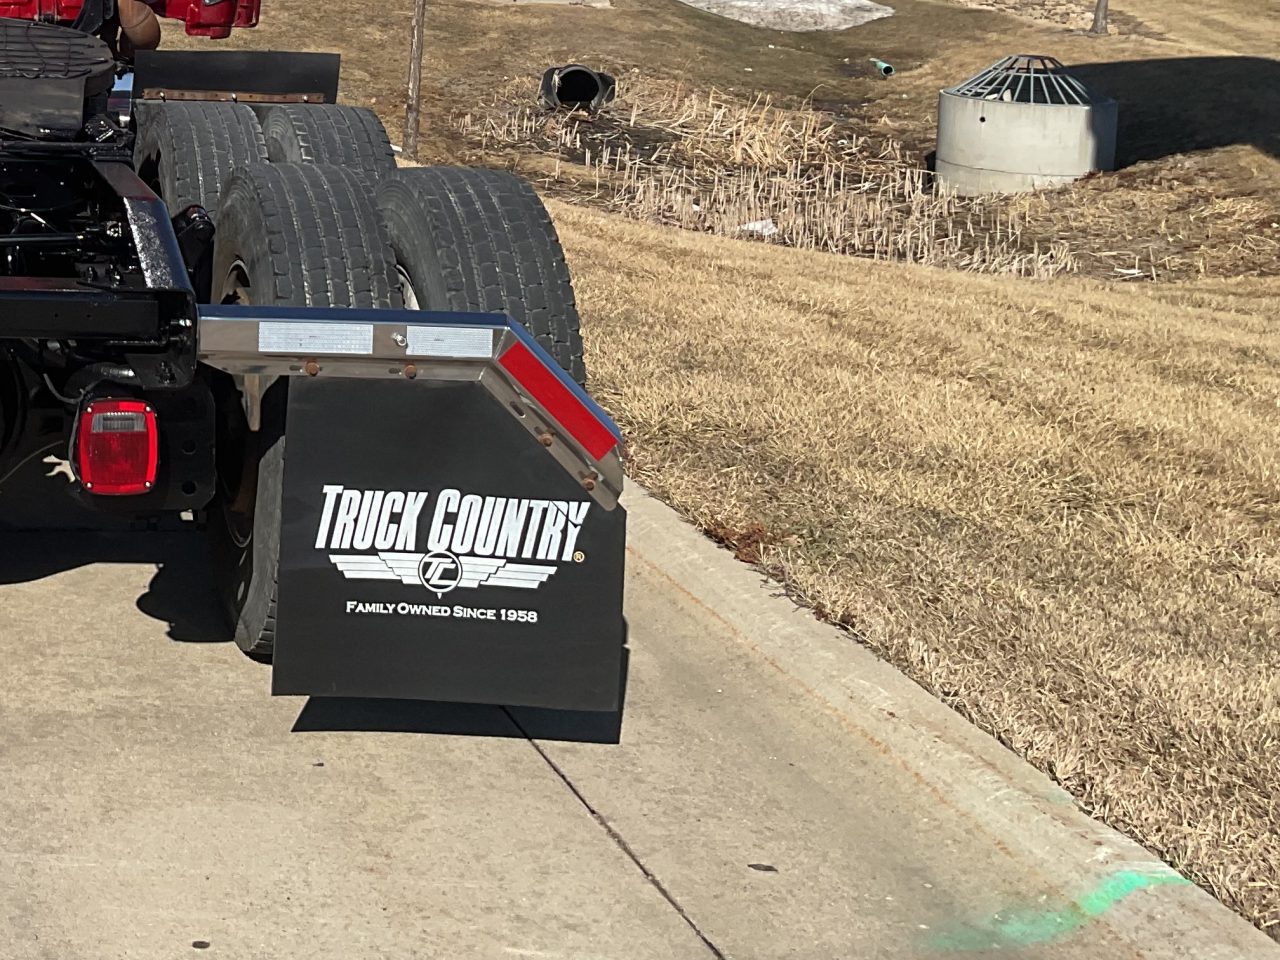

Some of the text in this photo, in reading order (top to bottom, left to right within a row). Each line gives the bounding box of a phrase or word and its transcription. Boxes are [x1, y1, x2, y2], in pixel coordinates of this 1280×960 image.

[315, 485, 428, 551] TRUCK
[346, 601, 538, 623] FAMILY OWNED SINCE 1958
